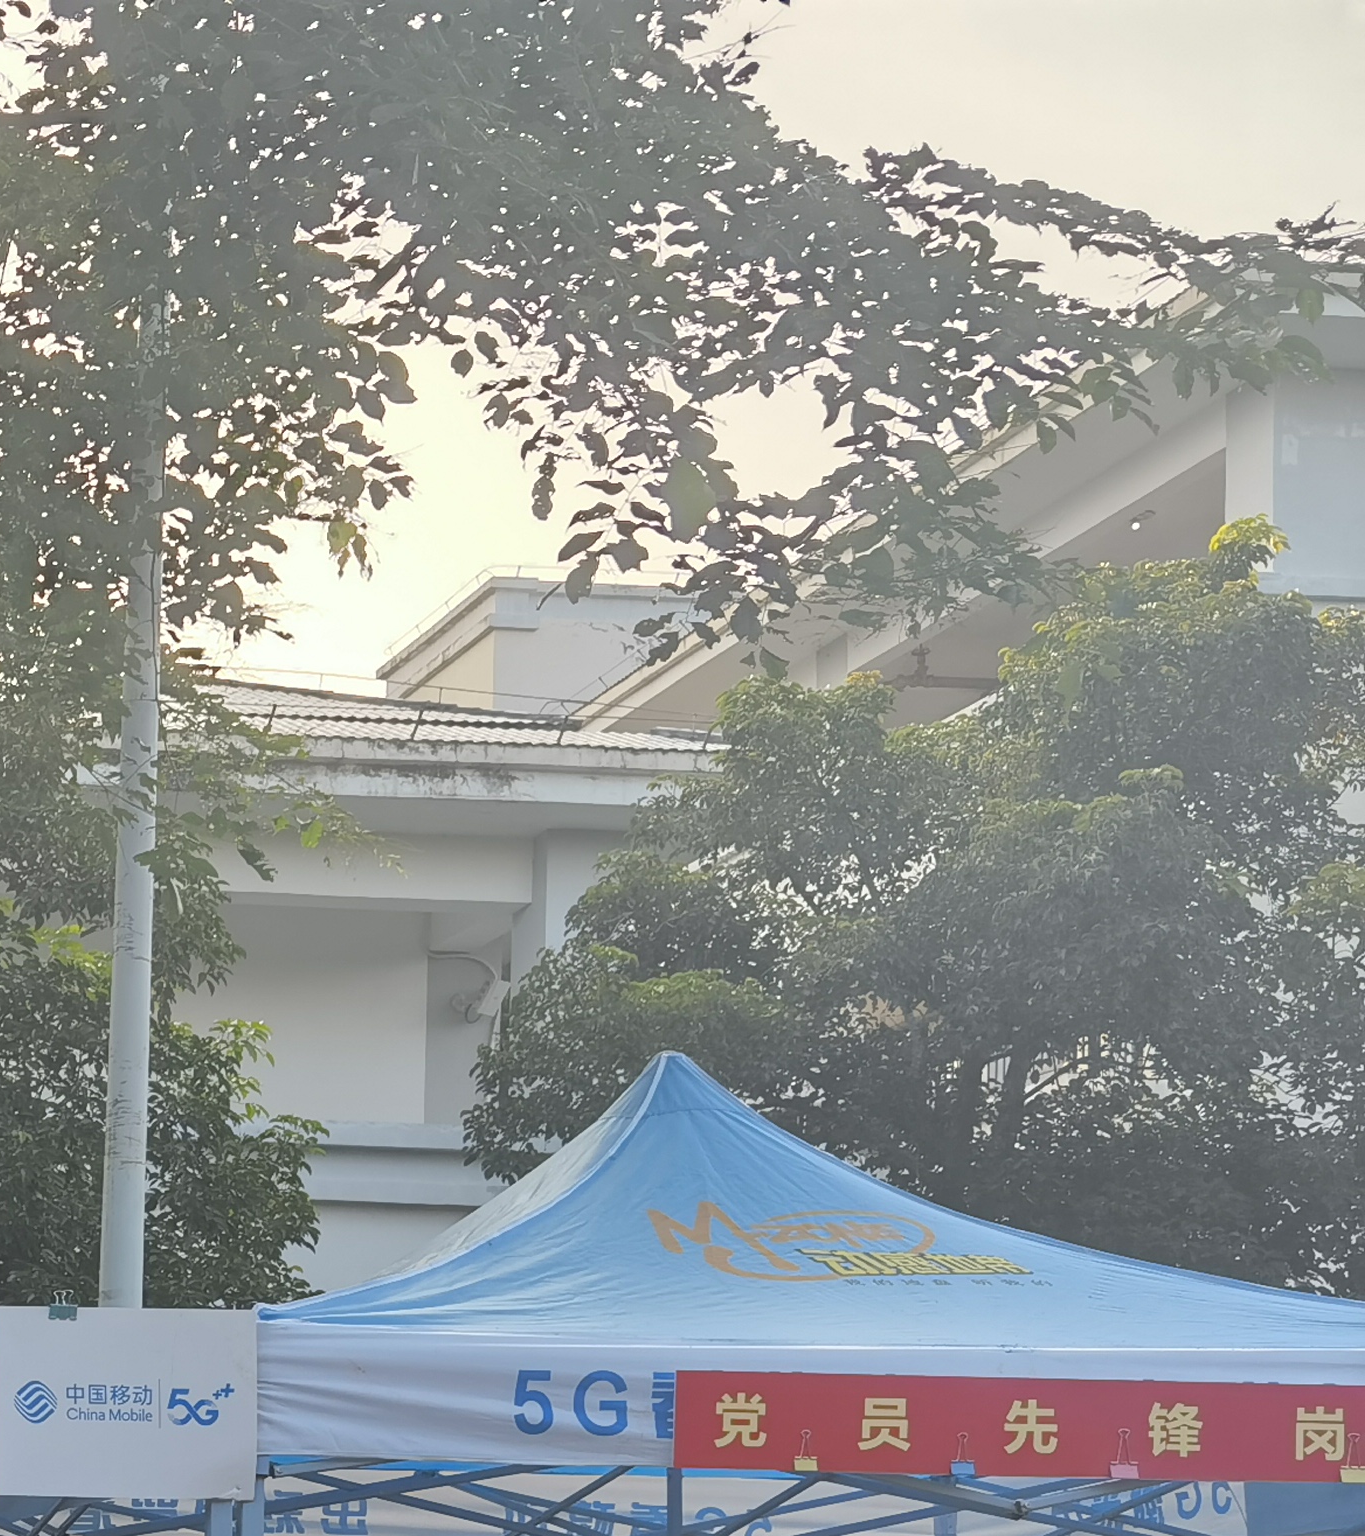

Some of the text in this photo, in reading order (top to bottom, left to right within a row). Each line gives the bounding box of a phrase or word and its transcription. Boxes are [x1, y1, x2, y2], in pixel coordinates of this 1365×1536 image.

[66, 1383, 153, 1406] 中国移动
[66, 1408, 153, 1422] China Mobile
[714, 1391, 1348, 1463] 党员先锋岗
